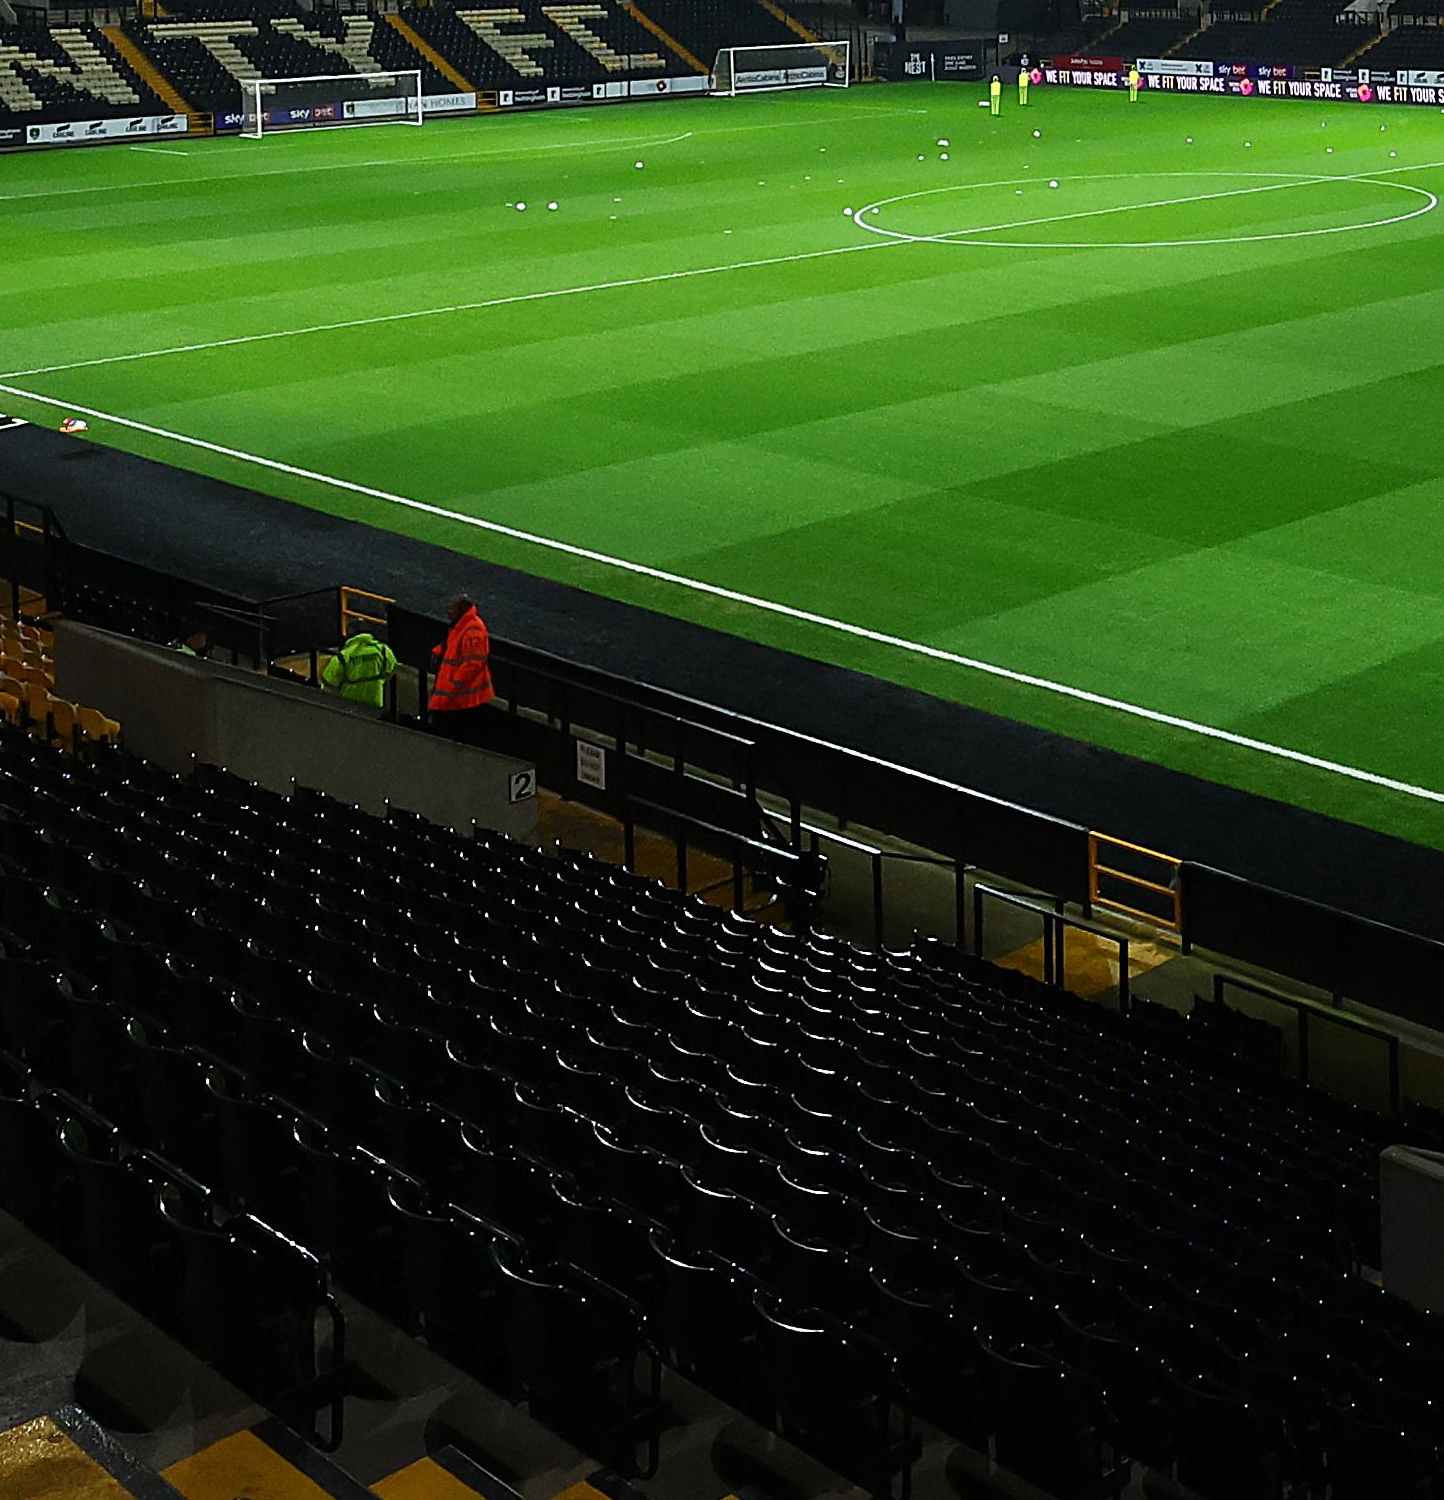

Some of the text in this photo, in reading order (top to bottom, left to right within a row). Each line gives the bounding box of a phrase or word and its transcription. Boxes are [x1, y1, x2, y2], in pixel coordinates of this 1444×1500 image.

[453, 3, 669, 78] FC
[904, 61, 926, 75] NEST
[1218, 65, 1231, 75] sky
[1258, 67, 1271, 77] sky
[1045, 69, 1117, 87] WE FIT YOUR SPACE
[1147, 75, 1161, 89] WE
[1162, 76, 1173, 90] FIT
[1176, 77, 1197, 91] YOUR
[1199, 78, 1225, 92] SPACE
[1258, 80, 1271, 94] WE
[1272, 81, 1286, 95] FIT
[1288, 82, 1311, 97] YOUR
[1313, 83, 1342, 99] SPACE
[1377, 85, 1392, 100] WE
[1394, 86, 1406, 101] FIT
[1410, 87, 1436, 103] YOUR
[224, 112, 244, 126] sky
[290, 108, 310, 119] sky
[515, 772, 531, 800] 2
